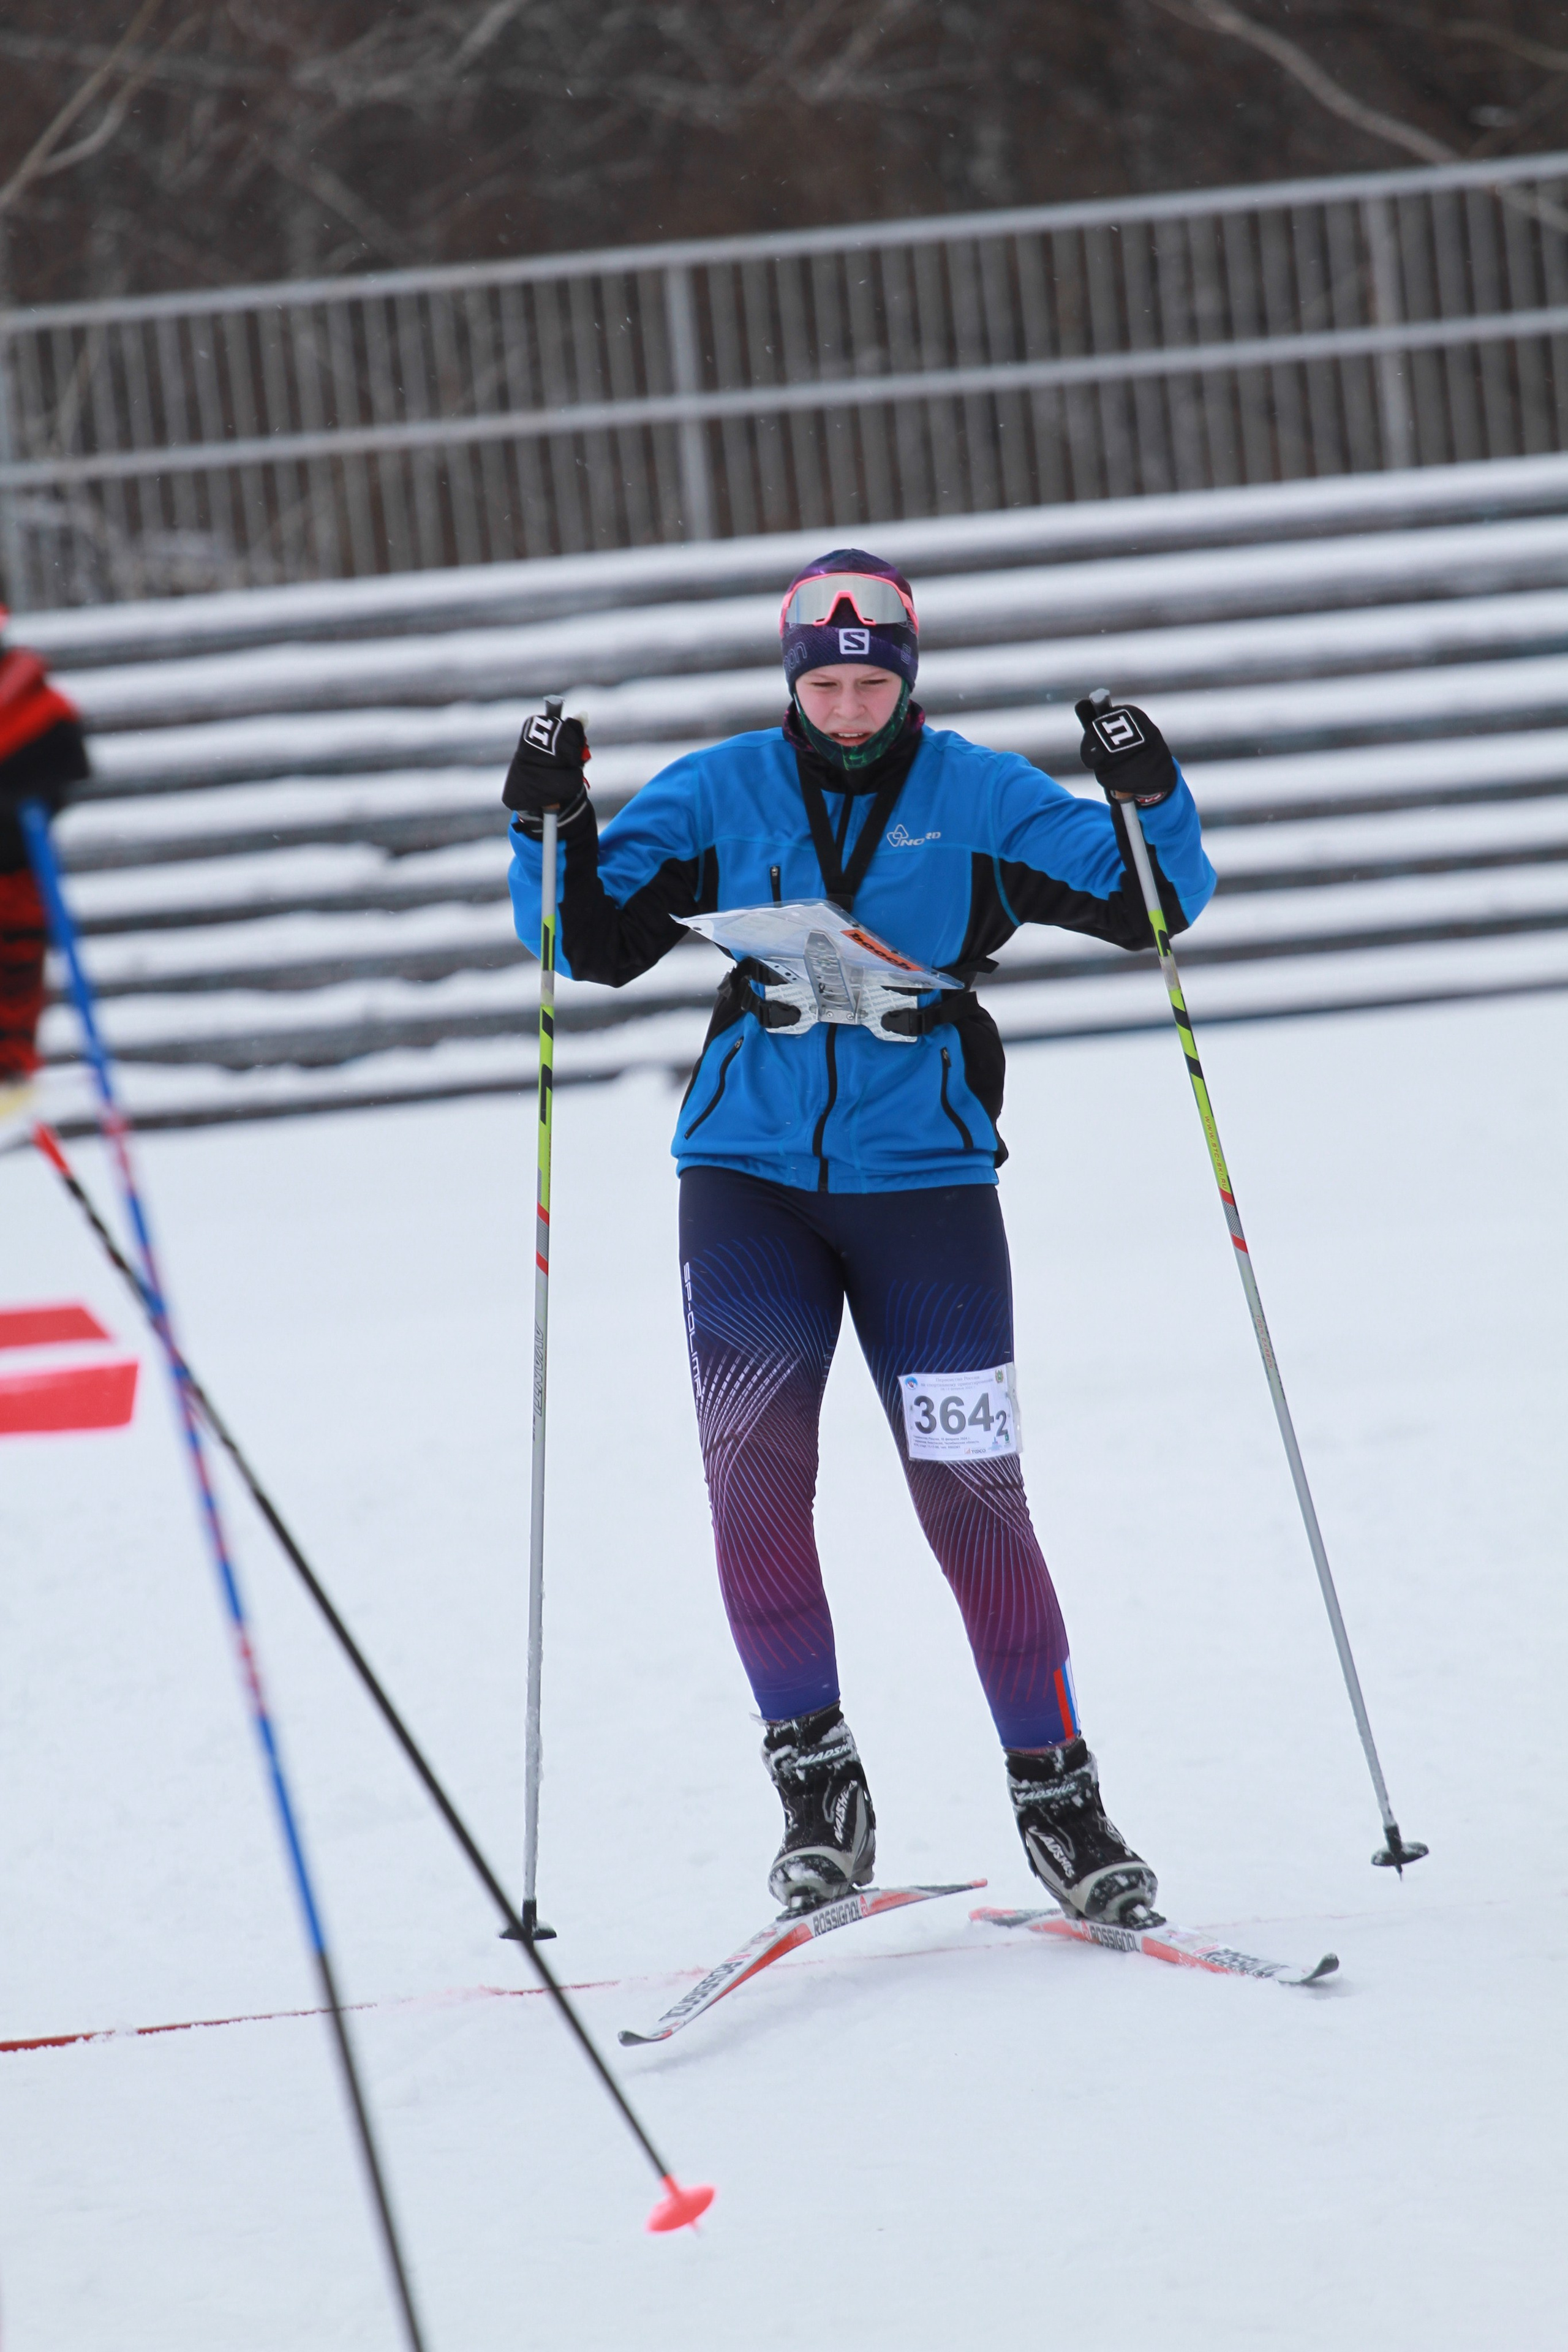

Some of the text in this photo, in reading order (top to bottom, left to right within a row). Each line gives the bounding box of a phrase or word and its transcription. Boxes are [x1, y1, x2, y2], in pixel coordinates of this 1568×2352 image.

[849, 933, 911, 970] booch
[1204, 1115, 1227, 1190] WWW.STC-SKI.RU
[533, 1321, 544, 1417] AVANTI
[1262, 1337, 1273, 1369] CARBON
[914, 1392, 1008, 1437] 364 2
[813, 1900, 862, 1937] ROSSIGNOL
